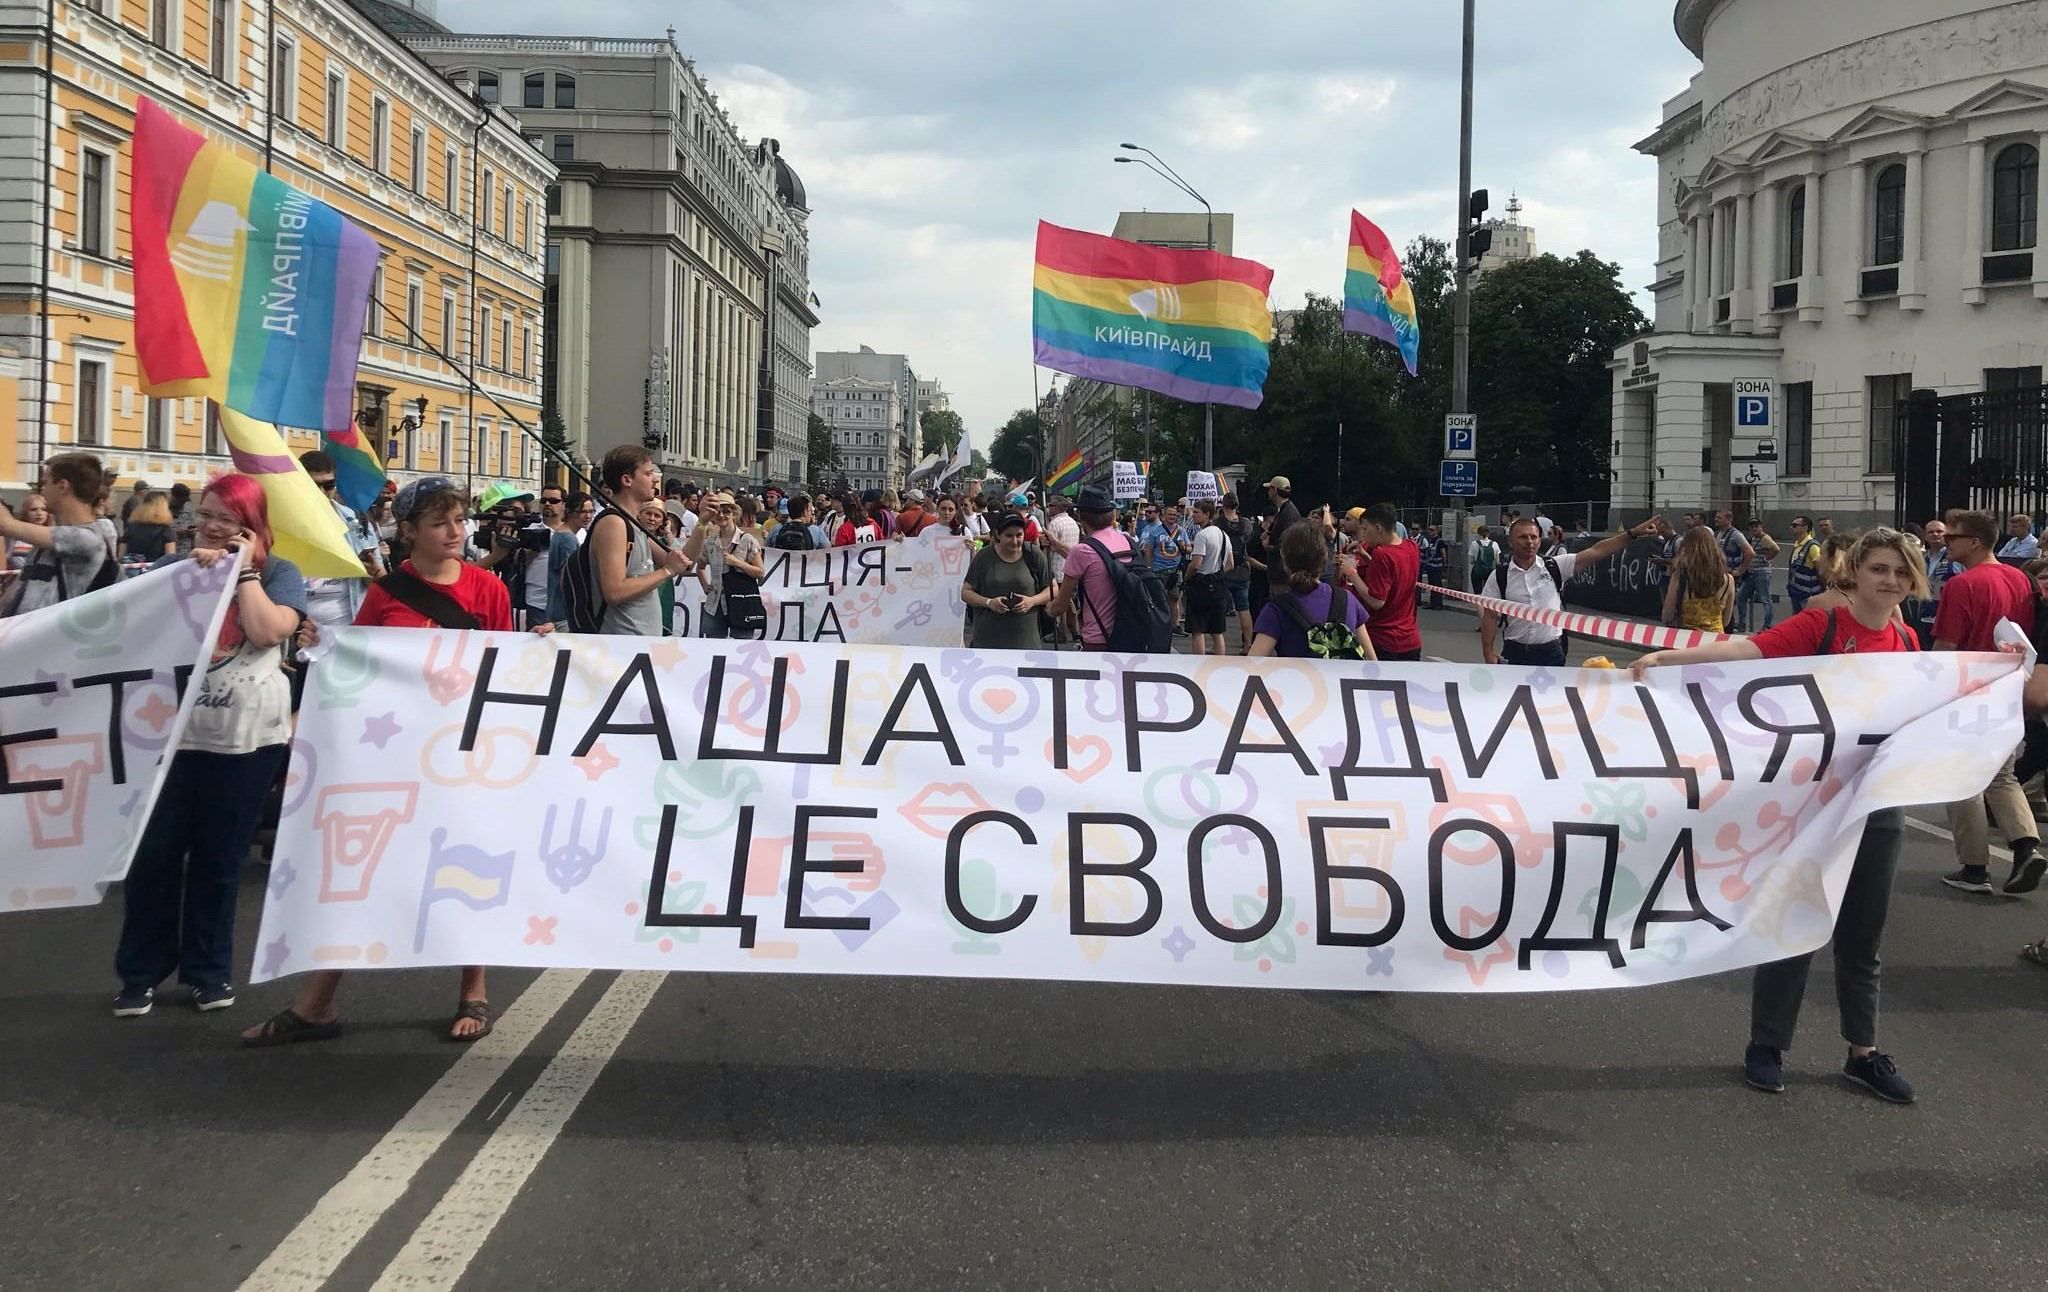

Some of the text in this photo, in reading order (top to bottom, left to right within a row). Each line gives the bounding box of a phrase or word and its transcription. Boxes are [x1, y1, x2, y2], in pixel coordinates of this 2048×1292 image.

[1095, 325, 1212, 362] КИЇВПРАЙД
[1736, 381, 1770, 393] ЗОНА
[1448, 417, 1473, 426] ЗОНА
[1188, 481, 1215, 490] КОХАЙ
[1607, 547, 1640, 592] the
[459, 646, 1893, 810] НАША ТРАДИЦІЯ-
[644, 803, 1734, 971] ЦЕ СВОБОДА
